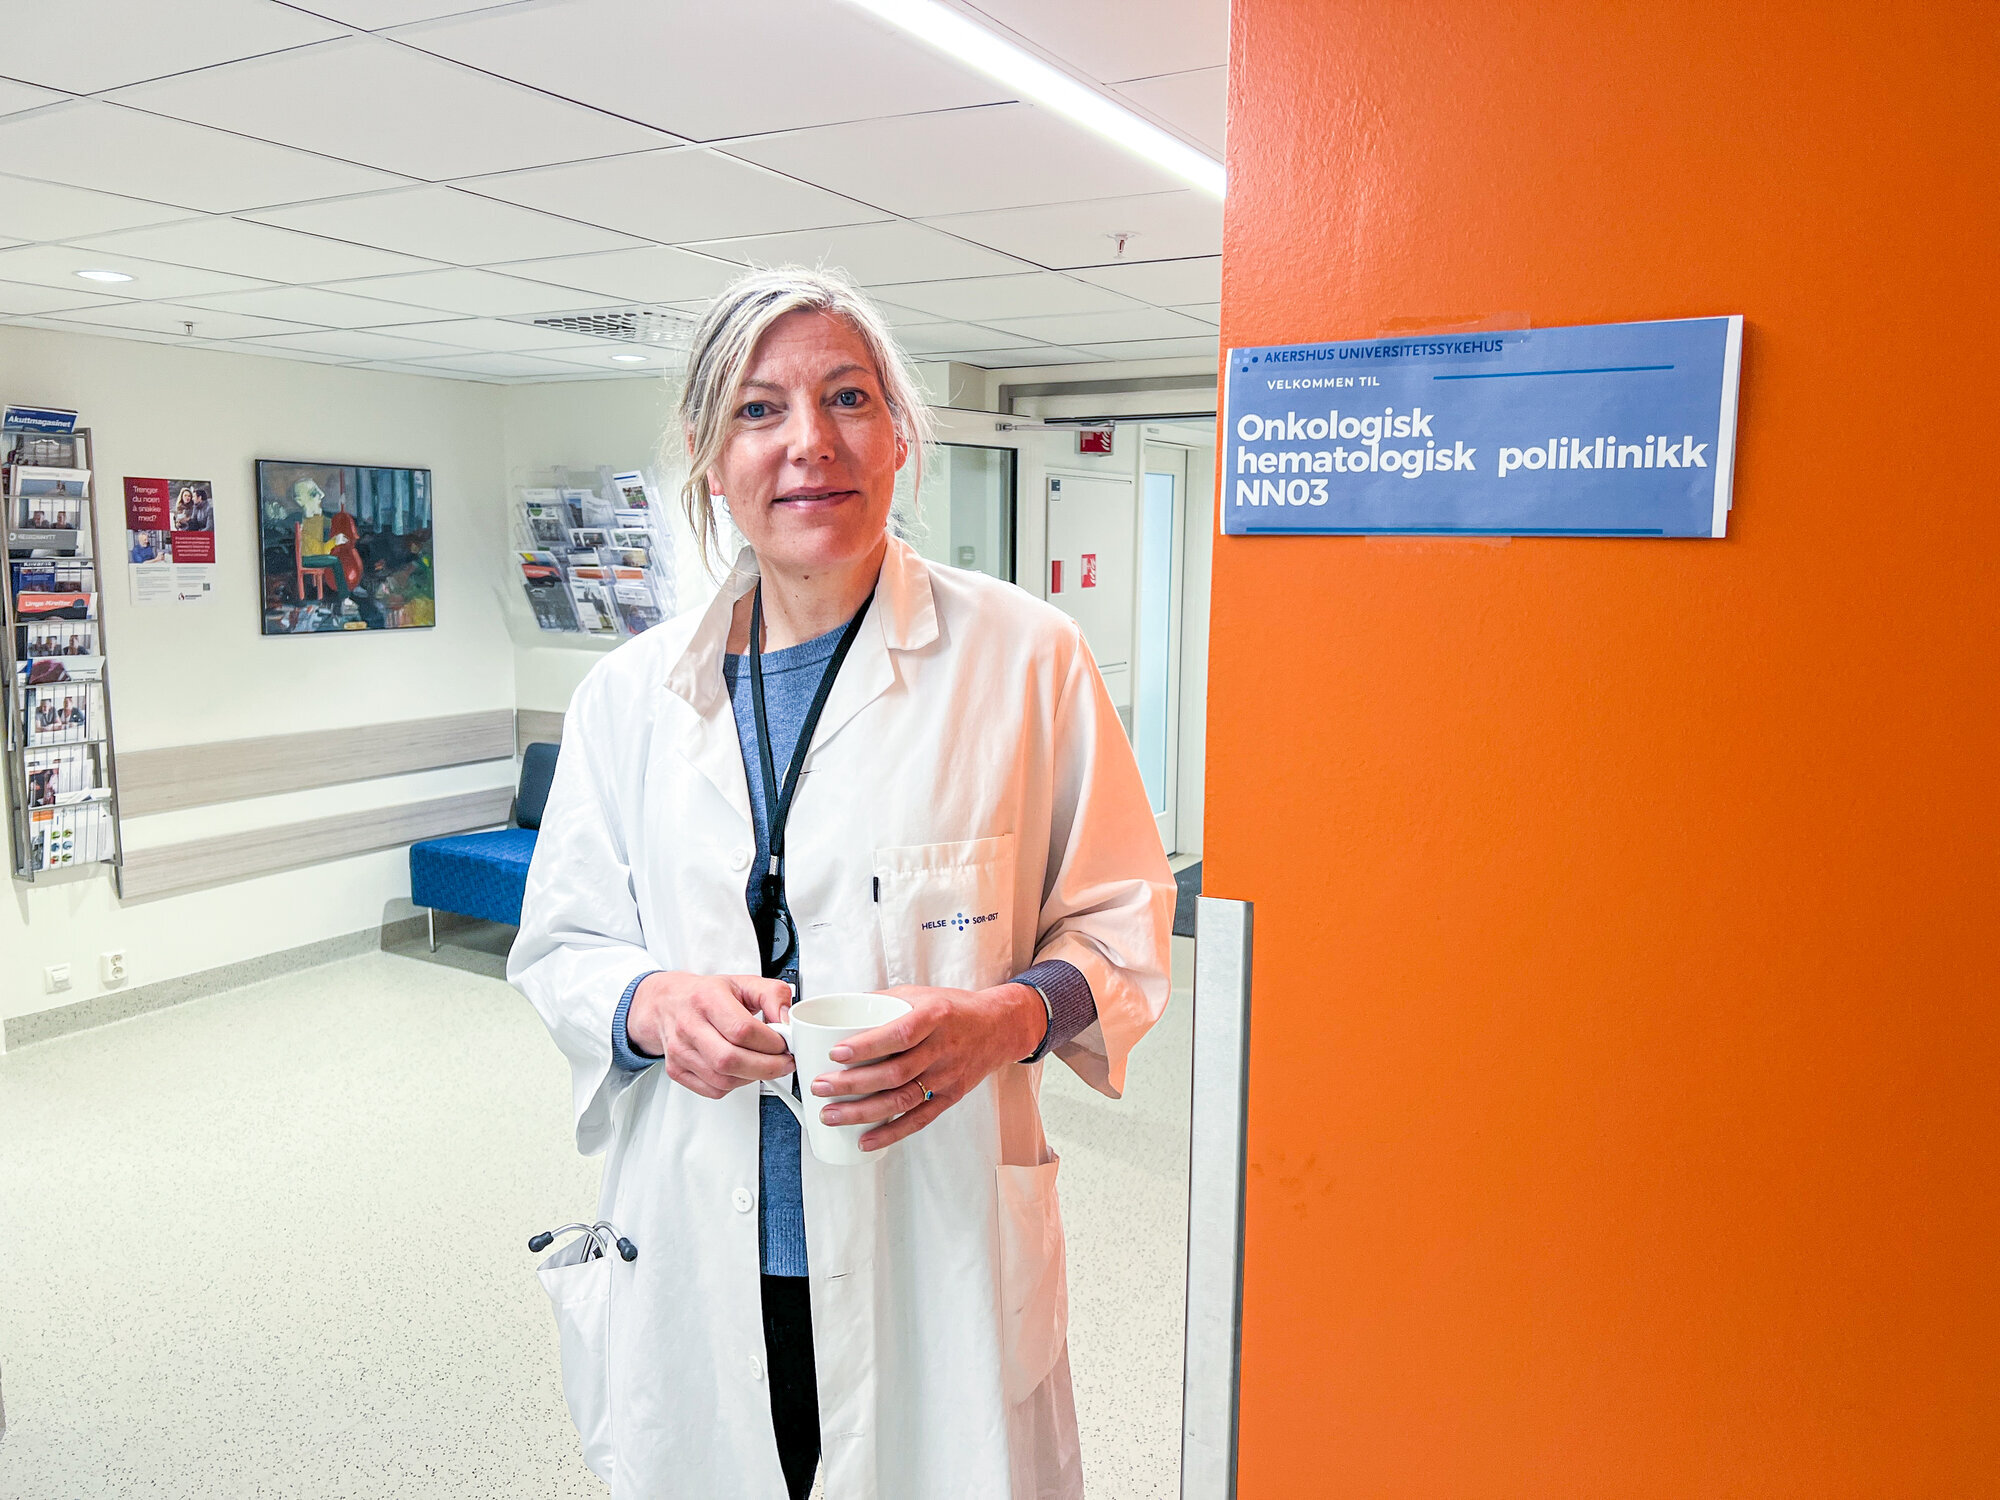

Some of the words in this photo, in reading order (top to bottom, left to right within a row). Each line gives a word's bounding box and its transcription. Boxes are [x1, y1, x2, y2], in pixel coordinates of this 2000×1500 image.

[1264, 348, 1335, 363] AKERSHUS
[1339, 339, 1503, 360] UNIVERSITETSSYKEHUS
[1267, 377, 1354, 390] VELKOMMEN
[1359, 376, 1380, 388] TIL
[7, 415, 71, 428] Akuttmagasinet
[1237, 407, 1435, 446] Onkologisk
[1237, 440, 1477, 479] hematologisk
[1498, 434, 1709, 478] poliklinikk
[132, 485, 158, 495] Trenger
[132, 495, 142, 503] du
[1236, 478, 1329, 507] NN03
[921, 919, 947, 931] HELSE
[972, 912, 999, 925] SØR-ØST
